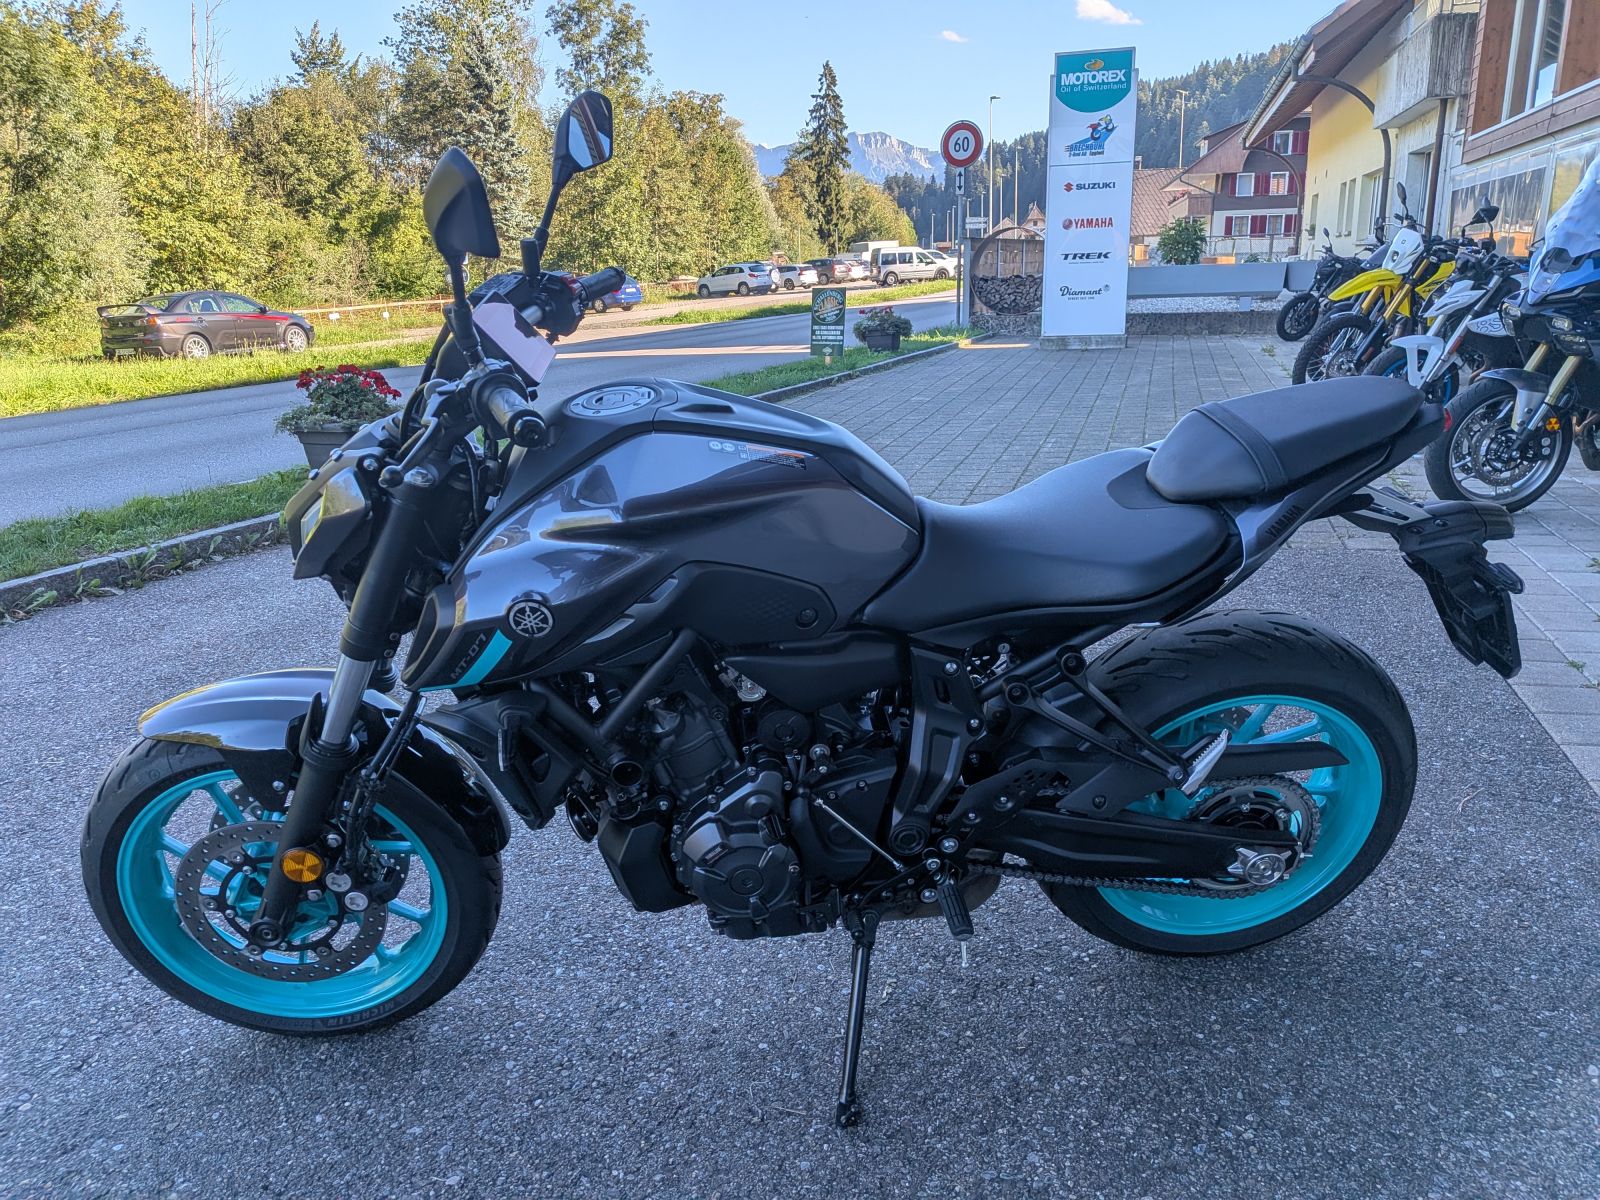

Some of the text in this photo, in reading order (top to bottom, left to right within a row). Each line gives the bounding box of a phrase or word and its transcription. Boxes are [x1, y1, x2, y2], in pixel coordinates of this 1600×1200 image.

[1061, 69, 1126, 86] MOTOREX
[1083, 82, 1127, 92] Switzerland
[953, 136, 969, 153] 60
[1075, 181, 1116, 191] SUZUKI
[1074, 217, 1114, 229] YAMAHA
[1060, 251, 1112, 260] TREK
[1059, 285, 1103, 297] Diamant
[1265, 504, 1304, 538] YAMAHA
[451, 633, 487, 679] MT-07
[327, 1001, 395, 1026] MICHELIN
